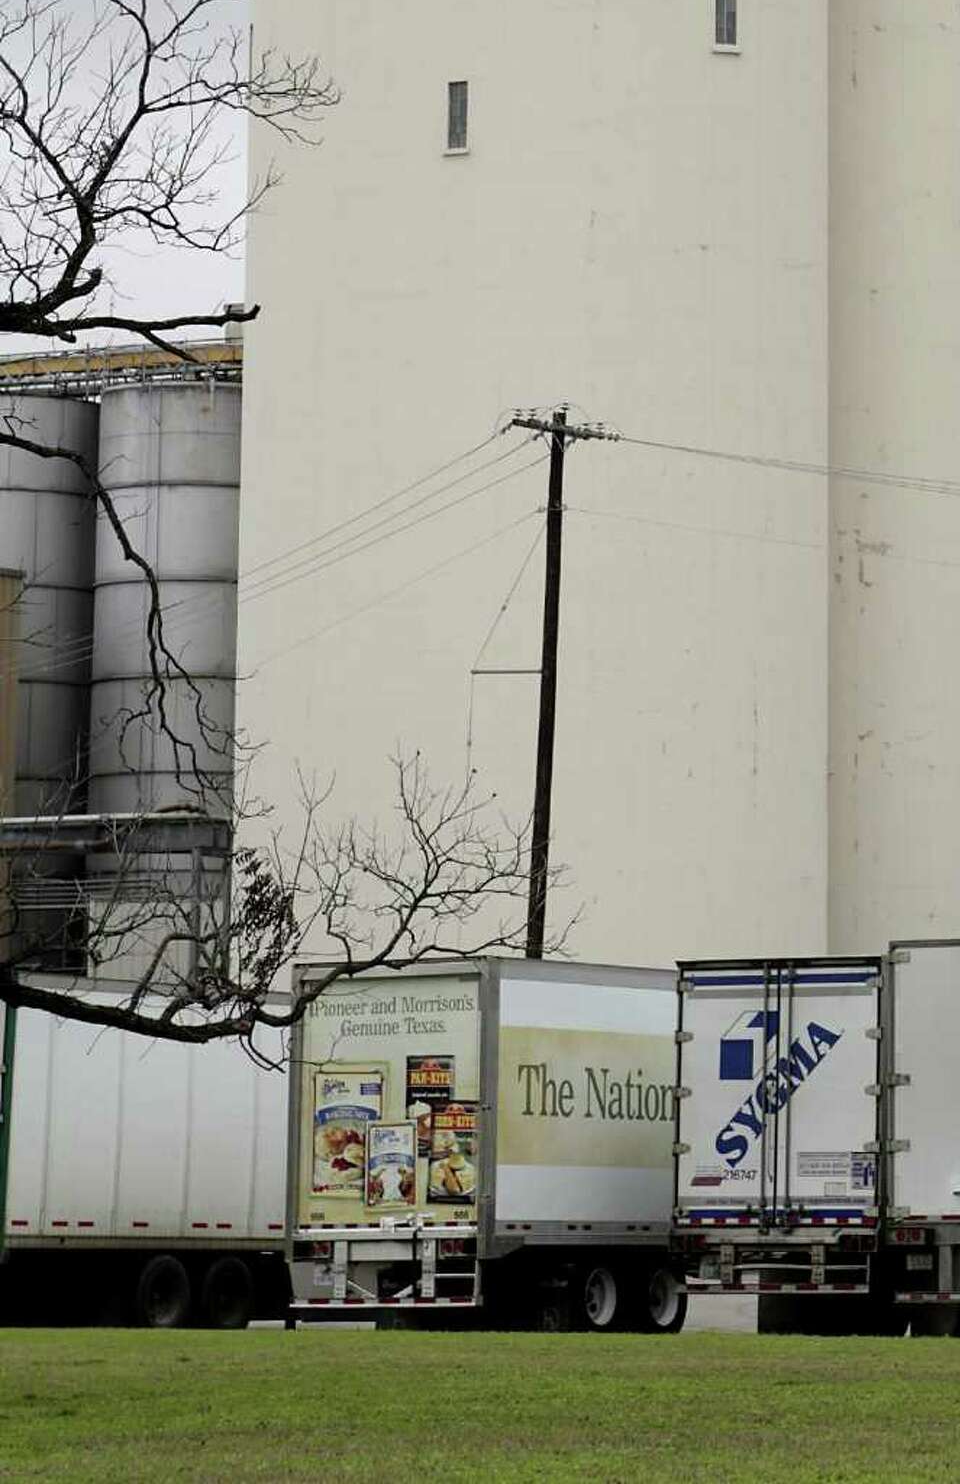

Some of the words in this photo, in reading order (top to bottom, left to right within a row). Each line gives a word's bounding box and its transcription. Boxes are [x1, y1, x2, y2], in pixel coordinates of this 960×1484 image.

[371, 996, 396, 1015] and
[402, 994, 475, 1014] Morrison's
[340, 1019, 400, 1038] Genuine
[404, 1017, 447, 1035] Texas
[518, 1063, 574, 1118] The
[715, 1021, 844, 1168] SYGMA
